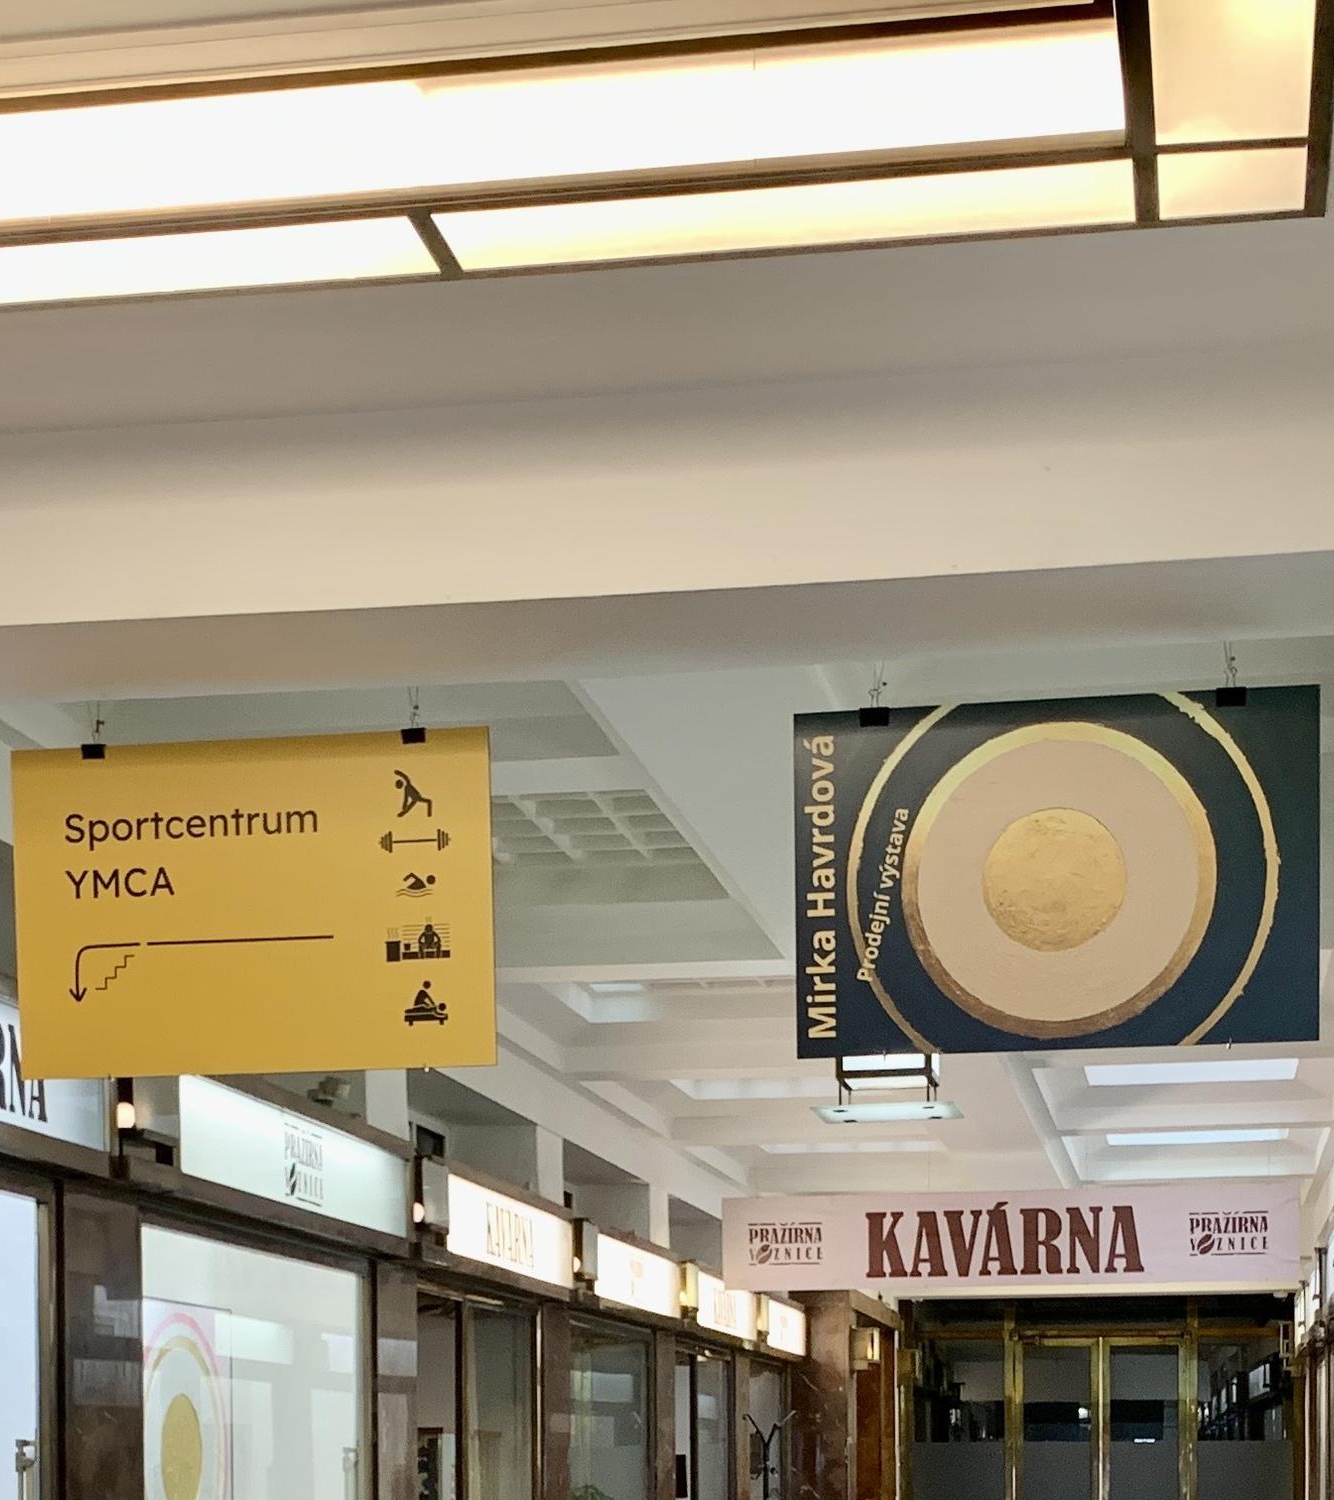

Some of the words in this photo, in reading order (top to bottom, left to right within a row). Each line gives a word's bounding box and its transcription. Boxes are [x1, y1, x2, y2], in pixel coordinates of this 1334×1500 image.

[64, 809, 319, 851] Sportcentrum
[803, 734, 836, 918] Havrdová
[64, 867, 176, 900] YMCA
[856, 890, 892, 982] Prodejní
[878, 807, 910, 892] výstava
[805, 929, 837, 1040] Mirka
[749, 1221, 823, 1245] PRAŽÍRNA
[865, 1201, 1145, 1278] KAVÁRNA
[1189, 1210, 1269, 1235] PRAŽÍRNA
